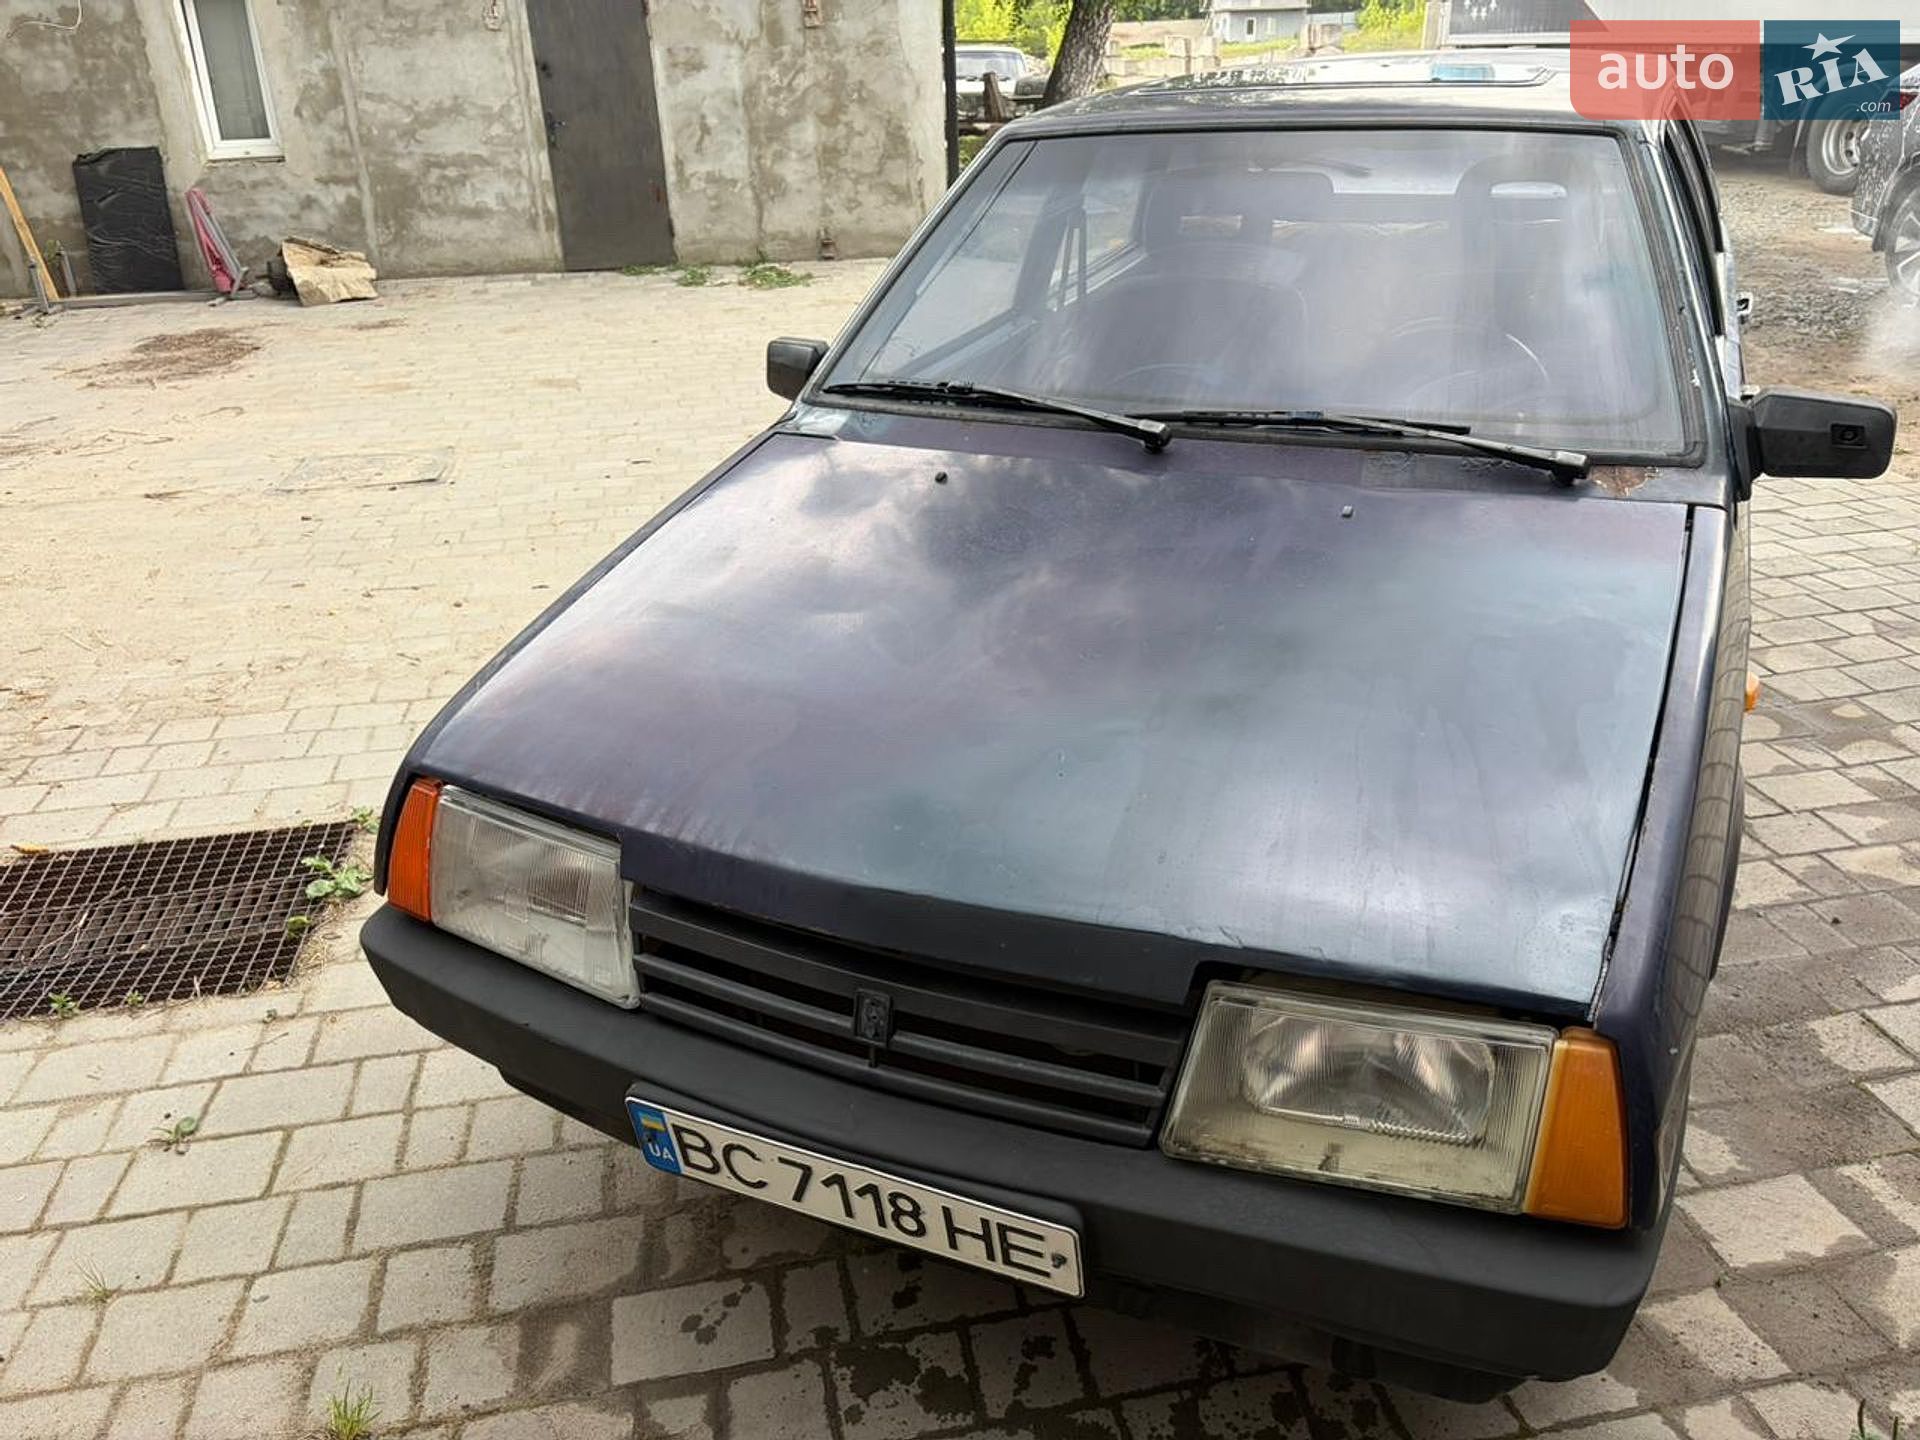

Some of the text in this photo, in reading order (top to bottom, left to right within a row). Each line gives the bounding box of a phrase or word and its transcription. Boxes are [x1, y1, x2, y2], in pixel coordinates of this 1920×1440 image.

[648, 1141, 675, 1163] UA
[671, 1123, 1051, 1278] BC 7118 HE
